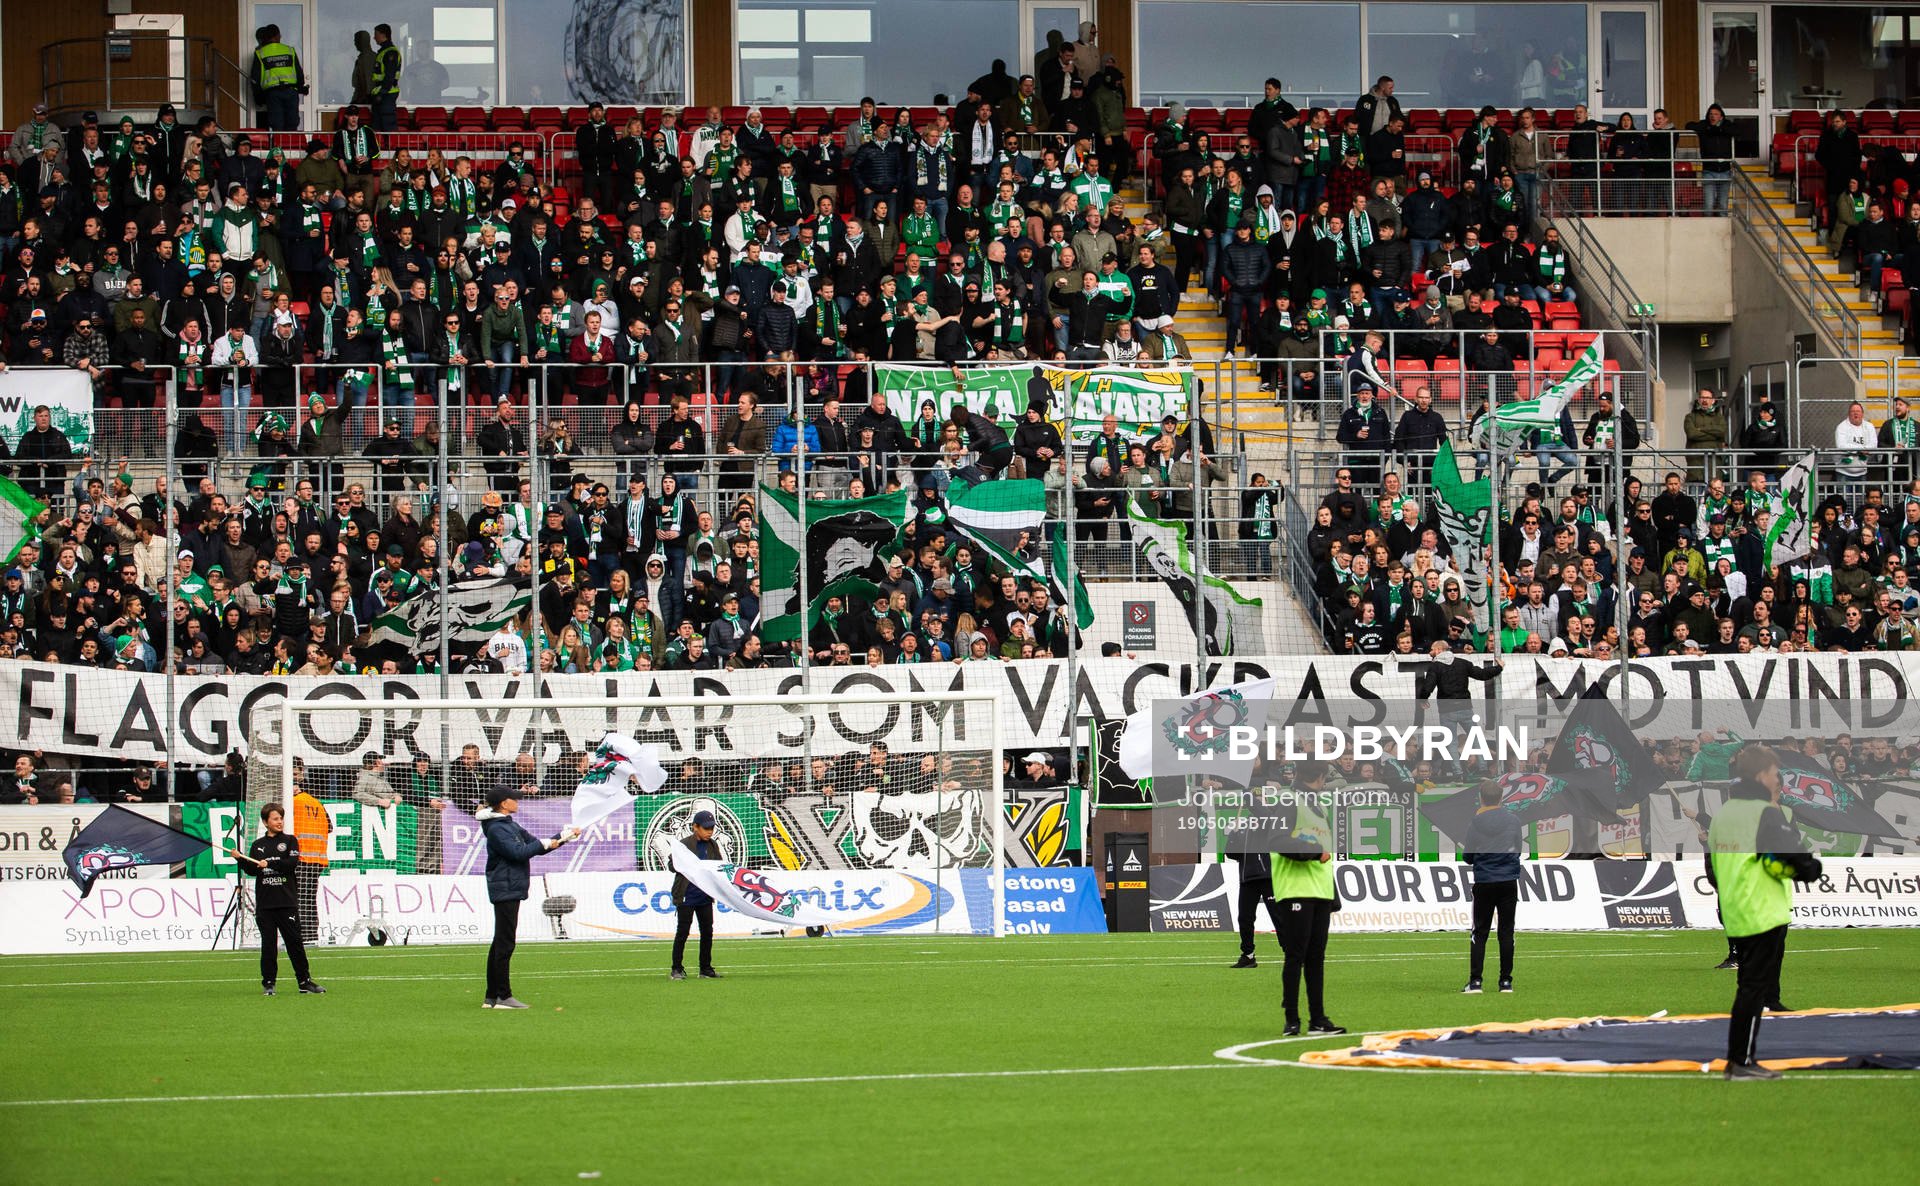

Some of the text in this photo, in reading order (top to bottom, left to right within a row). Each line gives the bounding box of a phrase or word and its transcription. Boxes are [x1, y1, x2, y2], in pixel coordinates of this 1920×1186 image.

[886, 389, 1017, 422] NACKA
[17, 668, 423, 756] FLAGGOR
[464, 675, 734, 756] VAJAR
[777, 667, 966, 748] SOM
[1534, 656, 1908, 731] MOTVIND
[38, 826, 58, 851] &
[208, 802, 399, 865] BEN
[1351, 808, 1401, 855] E1
[323, 883, 475, 915] MEDIA
[1616, 906, 1671, 915] NEW WAVE
[1162, 909, 1218, 919] NEW WAVE
[1164, 919, 1221, 929] PROFILE
[1619, 914, 1673, 924] PROFILE
[65, 925, 161, 946] Synlighet
[167, 923, 195, 941] för
[200, 923, 234, 941] ditt
